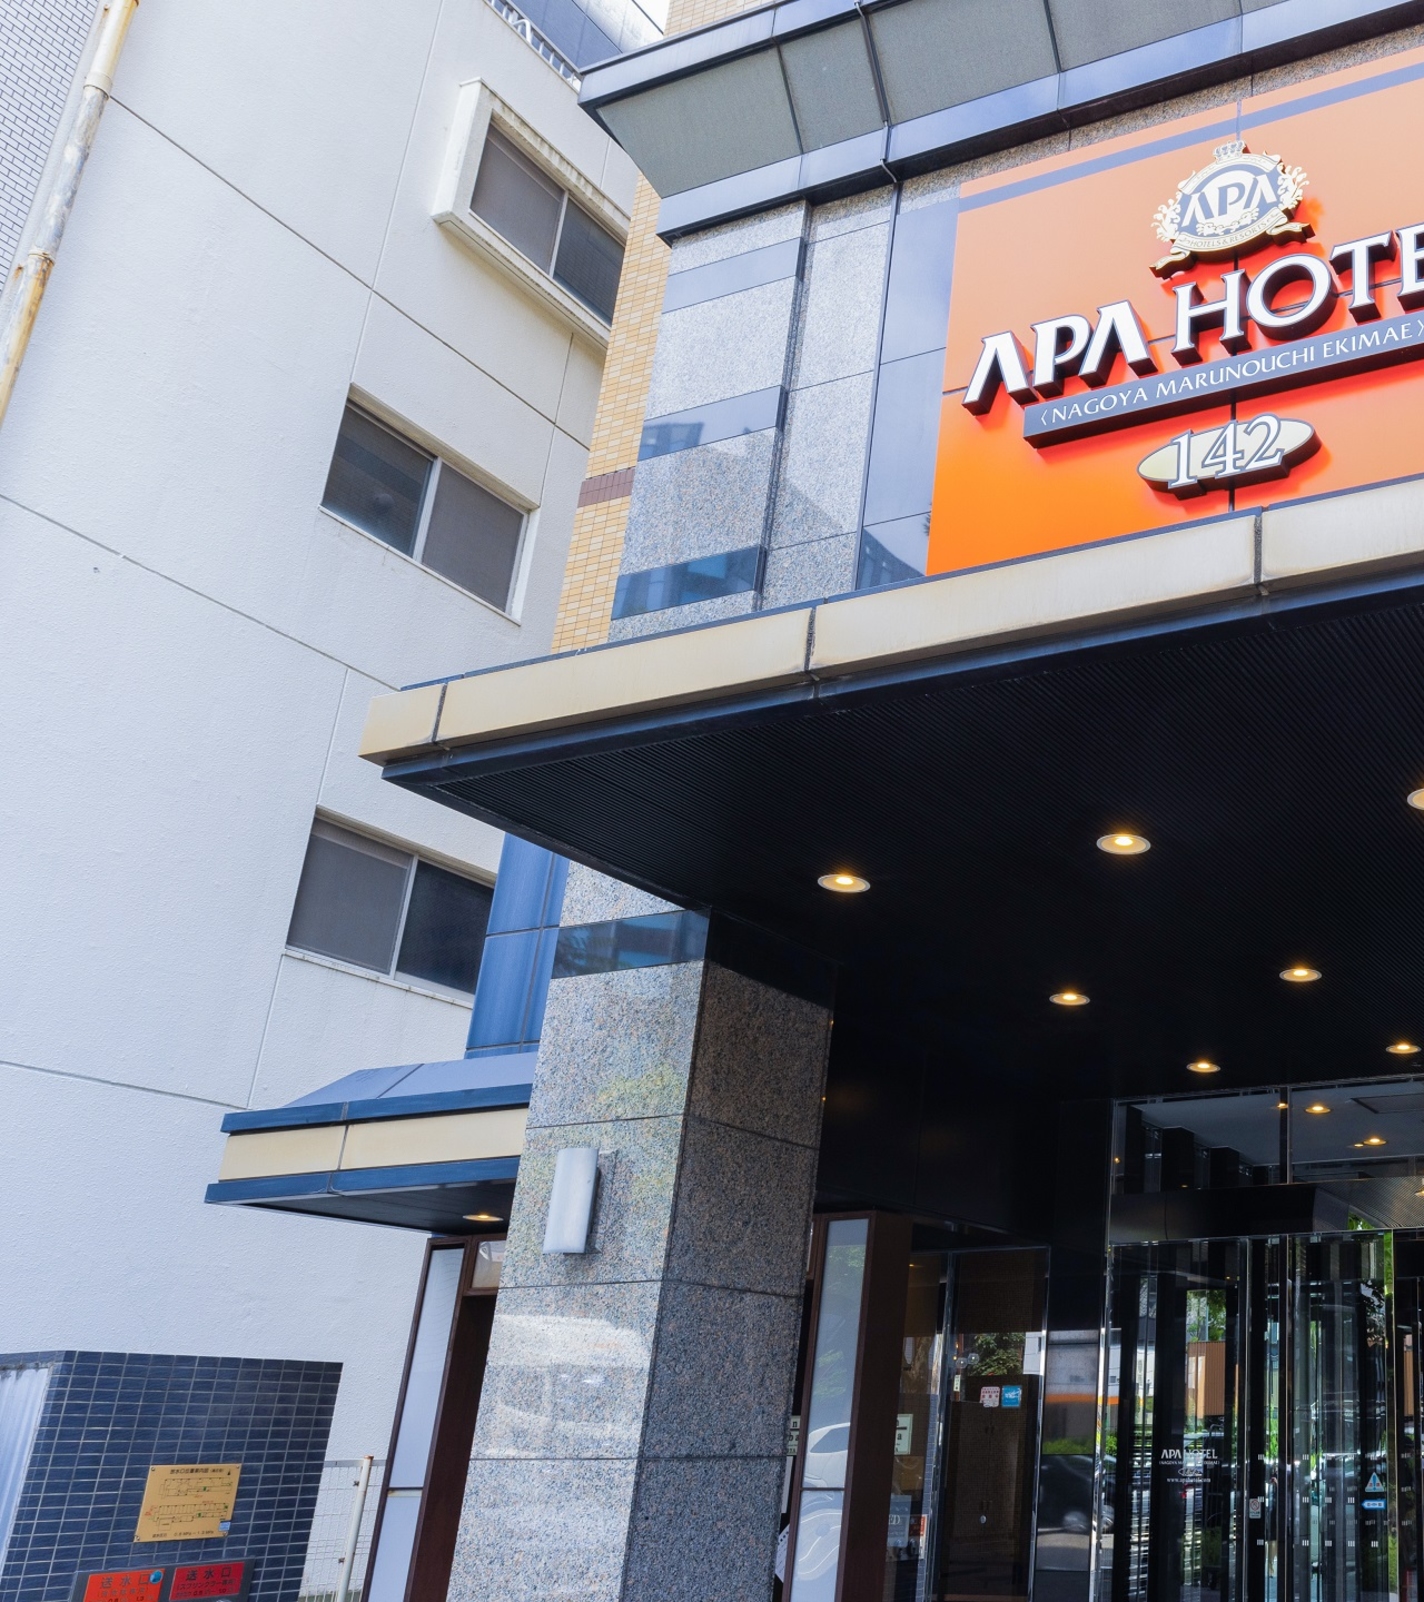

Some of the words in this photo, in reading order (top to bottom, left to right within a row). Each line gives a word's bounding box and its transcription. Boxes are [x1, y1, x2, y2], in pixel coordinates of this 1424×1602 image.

[1181, 174, 1278, 228] APA
[963, 299, 1152, 408] APA
[1156, 345, 1317, 398] MARUNOUCHI
[1170, 413, 1285, 490] 142
[1160, 1449, 1182, 1459] APA
[185, 1567, 232, 1581] 送水口
